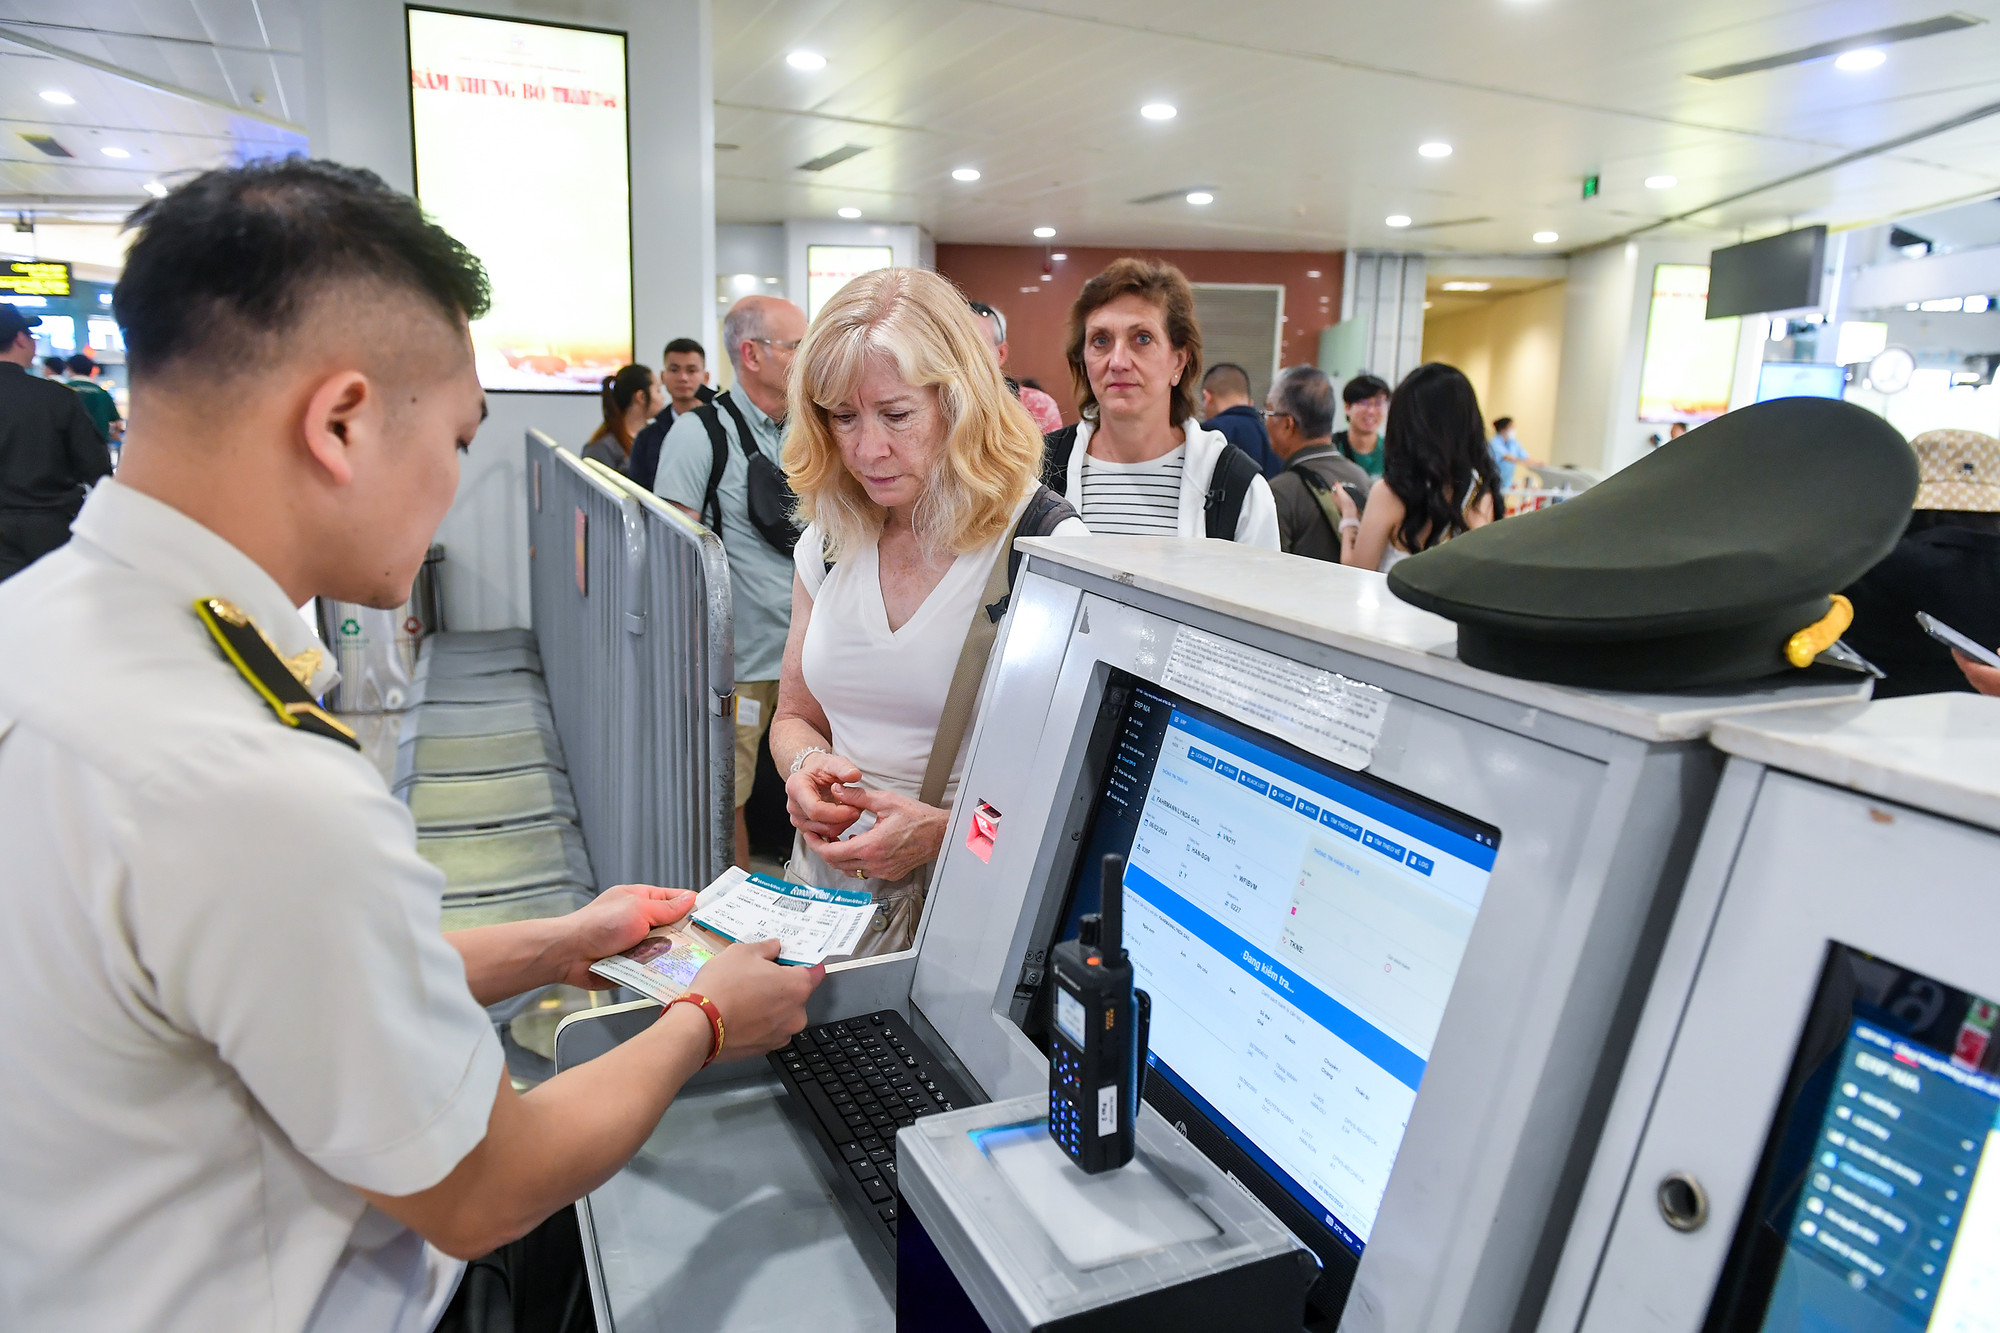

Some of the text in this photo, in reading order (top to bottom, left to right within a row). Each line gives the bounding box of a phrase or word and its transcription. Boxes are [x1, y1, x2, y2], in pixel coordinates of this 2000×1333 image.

[1418, 860, 1429, 869] LOG
[1242, 950, 1294, 993] Đang kiểm tra...
